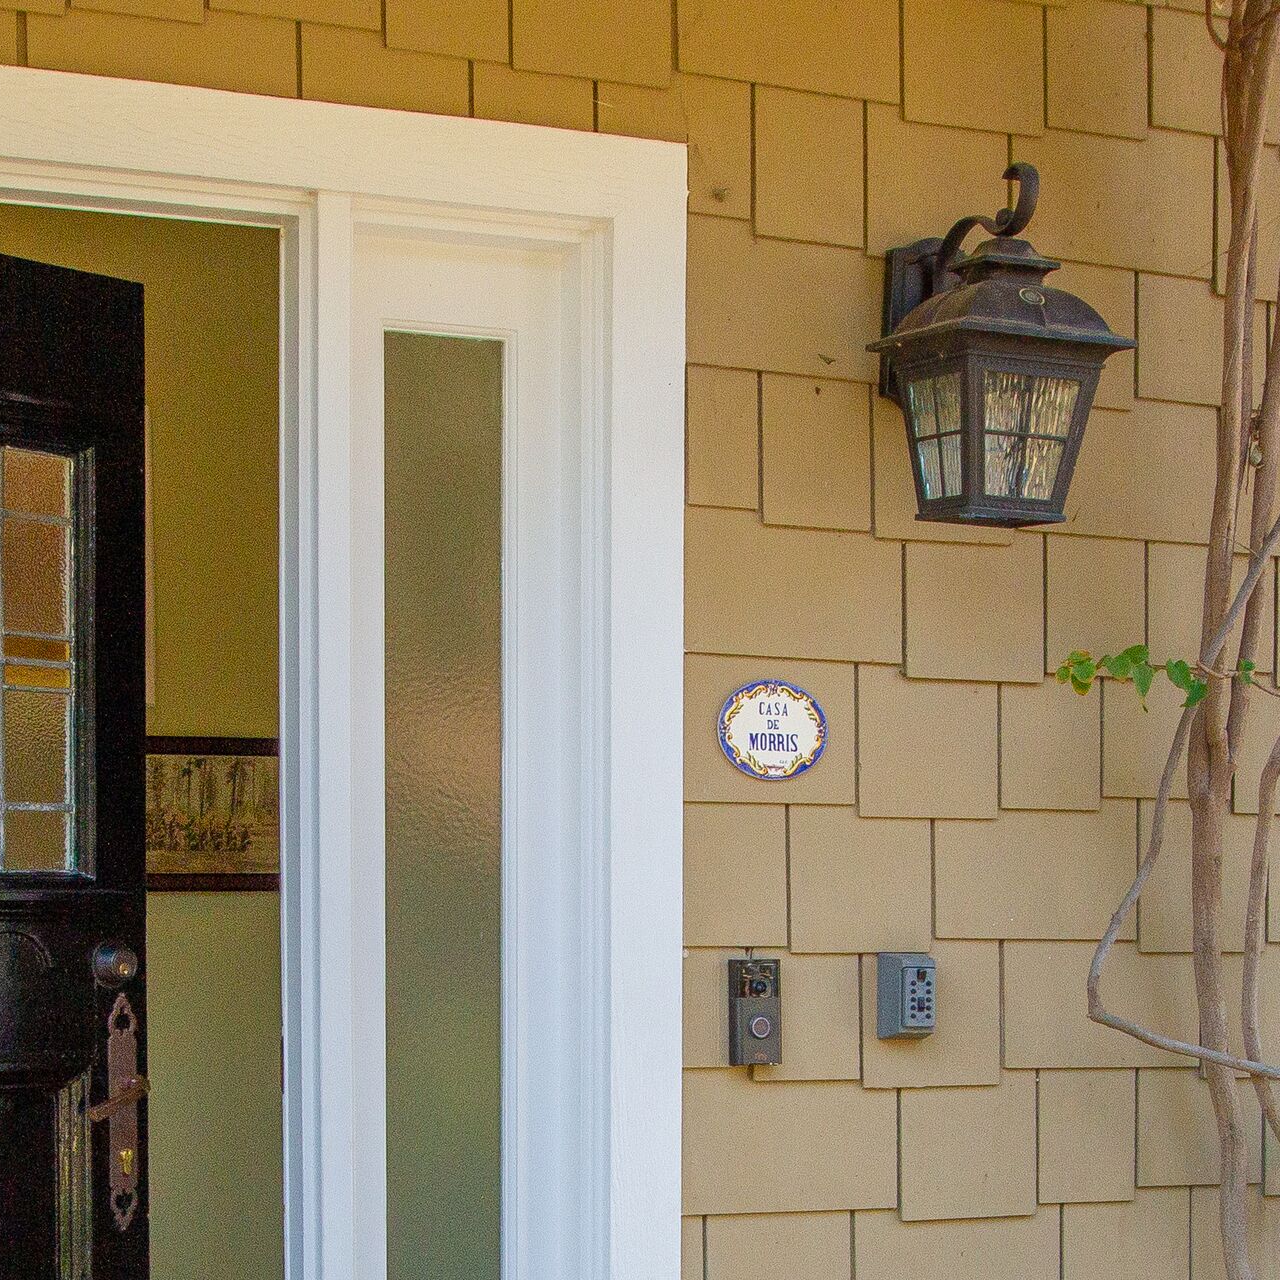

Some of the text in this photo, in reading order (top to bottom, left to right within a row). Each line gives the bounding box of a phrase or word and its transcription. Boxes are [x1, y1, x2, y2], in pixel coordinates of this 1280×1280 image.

[759, 702, 789, 716] CASA
[767, 720, 780, 730] DE
[749, 733, 798, 752] MORRIS
